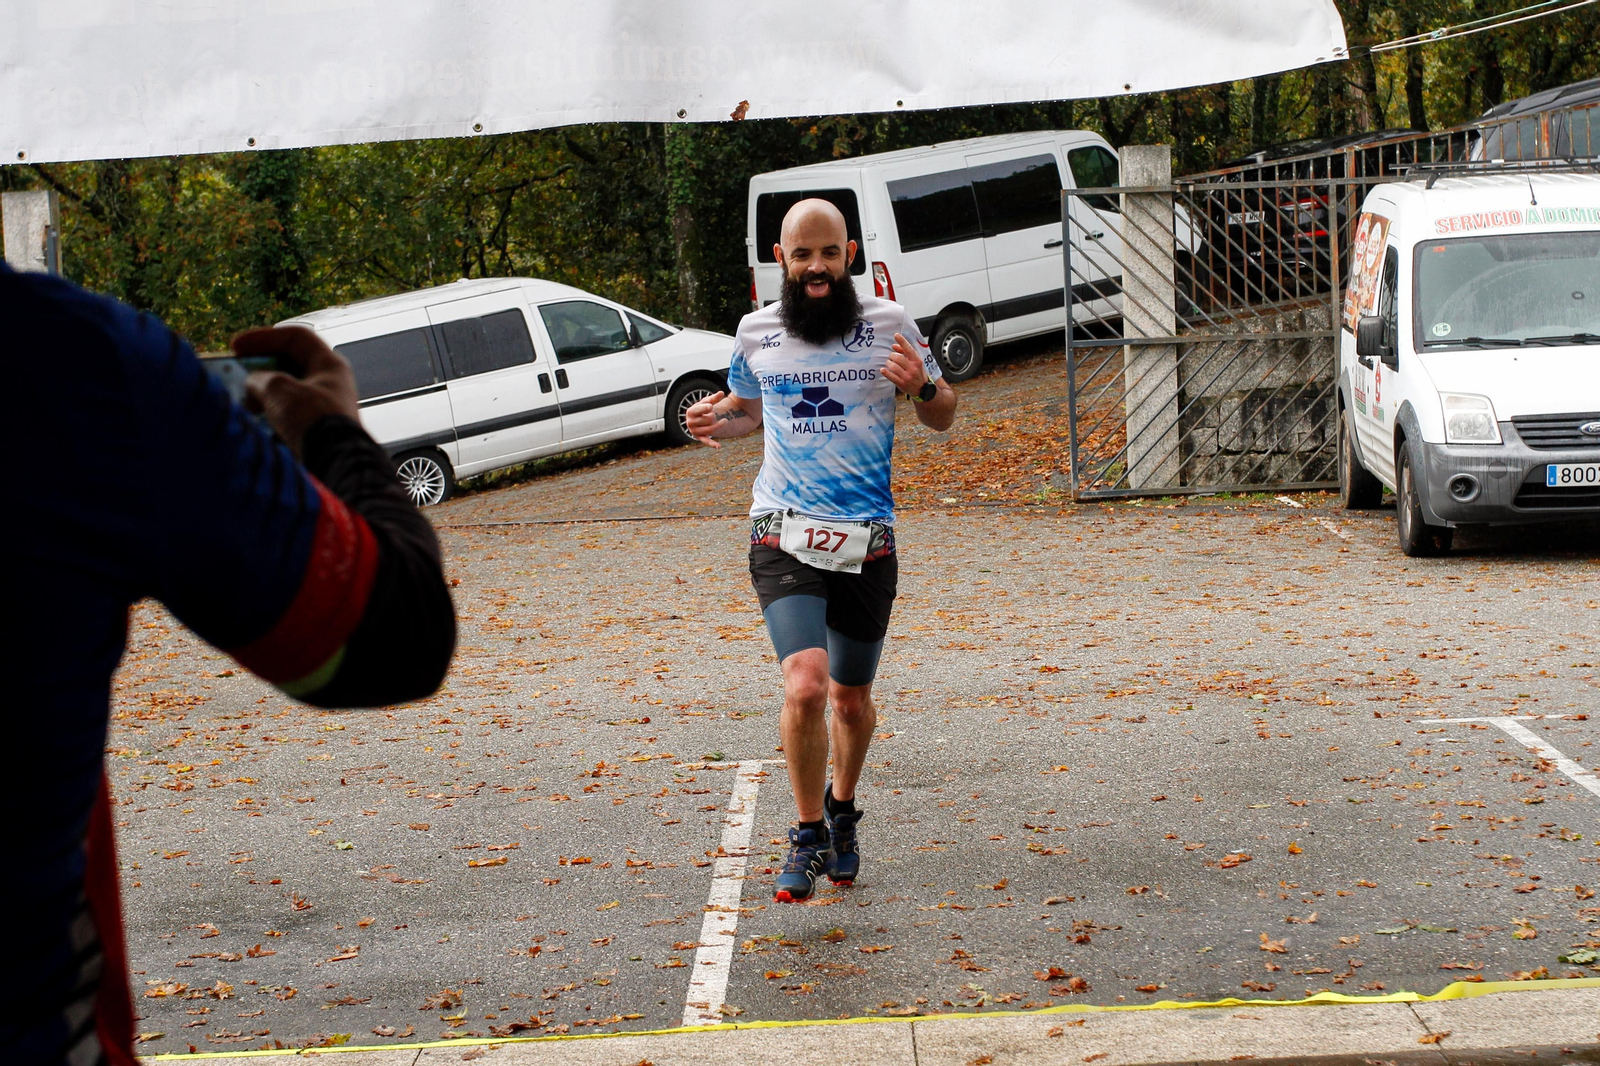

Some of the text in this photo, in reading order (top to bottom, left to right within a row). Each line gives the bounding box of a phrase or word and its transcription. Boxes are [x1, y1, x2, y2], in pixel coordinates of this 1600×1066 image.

[1436, 210, 1522, 234] SERVICIO
[1527, 208, 1541, 224] A
[762, 369, 876, 387] PREFABRICADOS
[792, 420, 848, 434] MALLAS
[804, 527, 849, 553] 127
